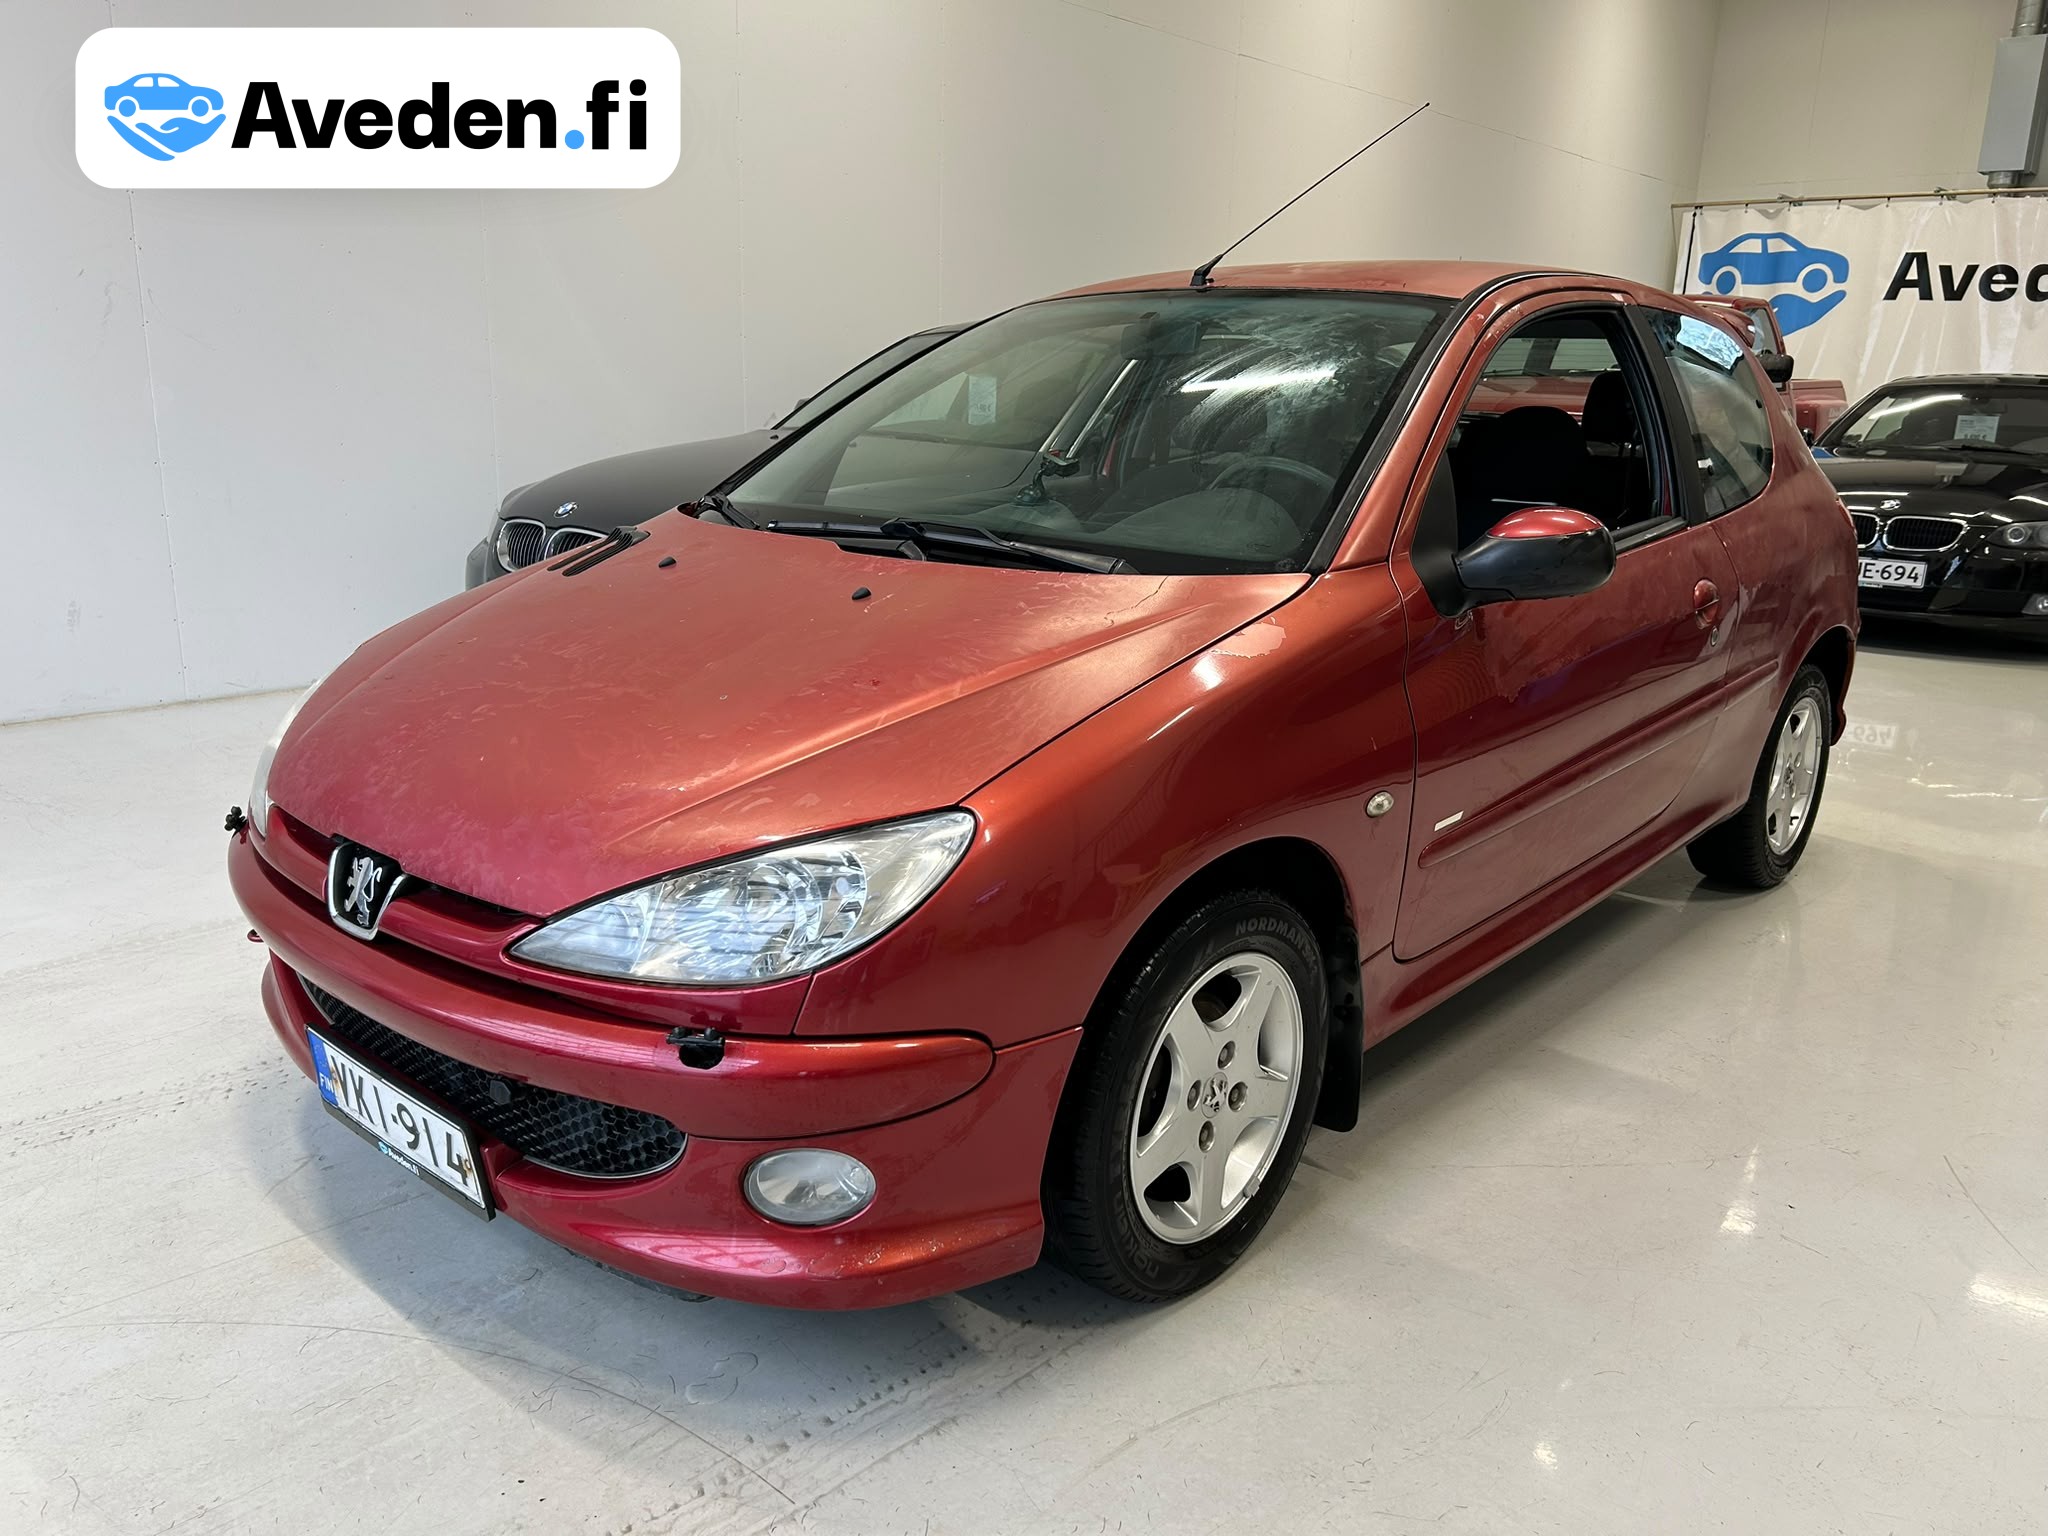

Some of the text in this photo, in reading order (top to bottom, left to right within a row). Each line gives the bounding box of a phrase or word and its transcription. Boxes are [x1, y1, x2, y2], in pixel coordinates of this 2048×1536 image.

[1235, 916, 1306, 951] NORDMAN
[320, 1072, 334, 1093] FIN
[330, 1055, 469, 1186] VKI-914
